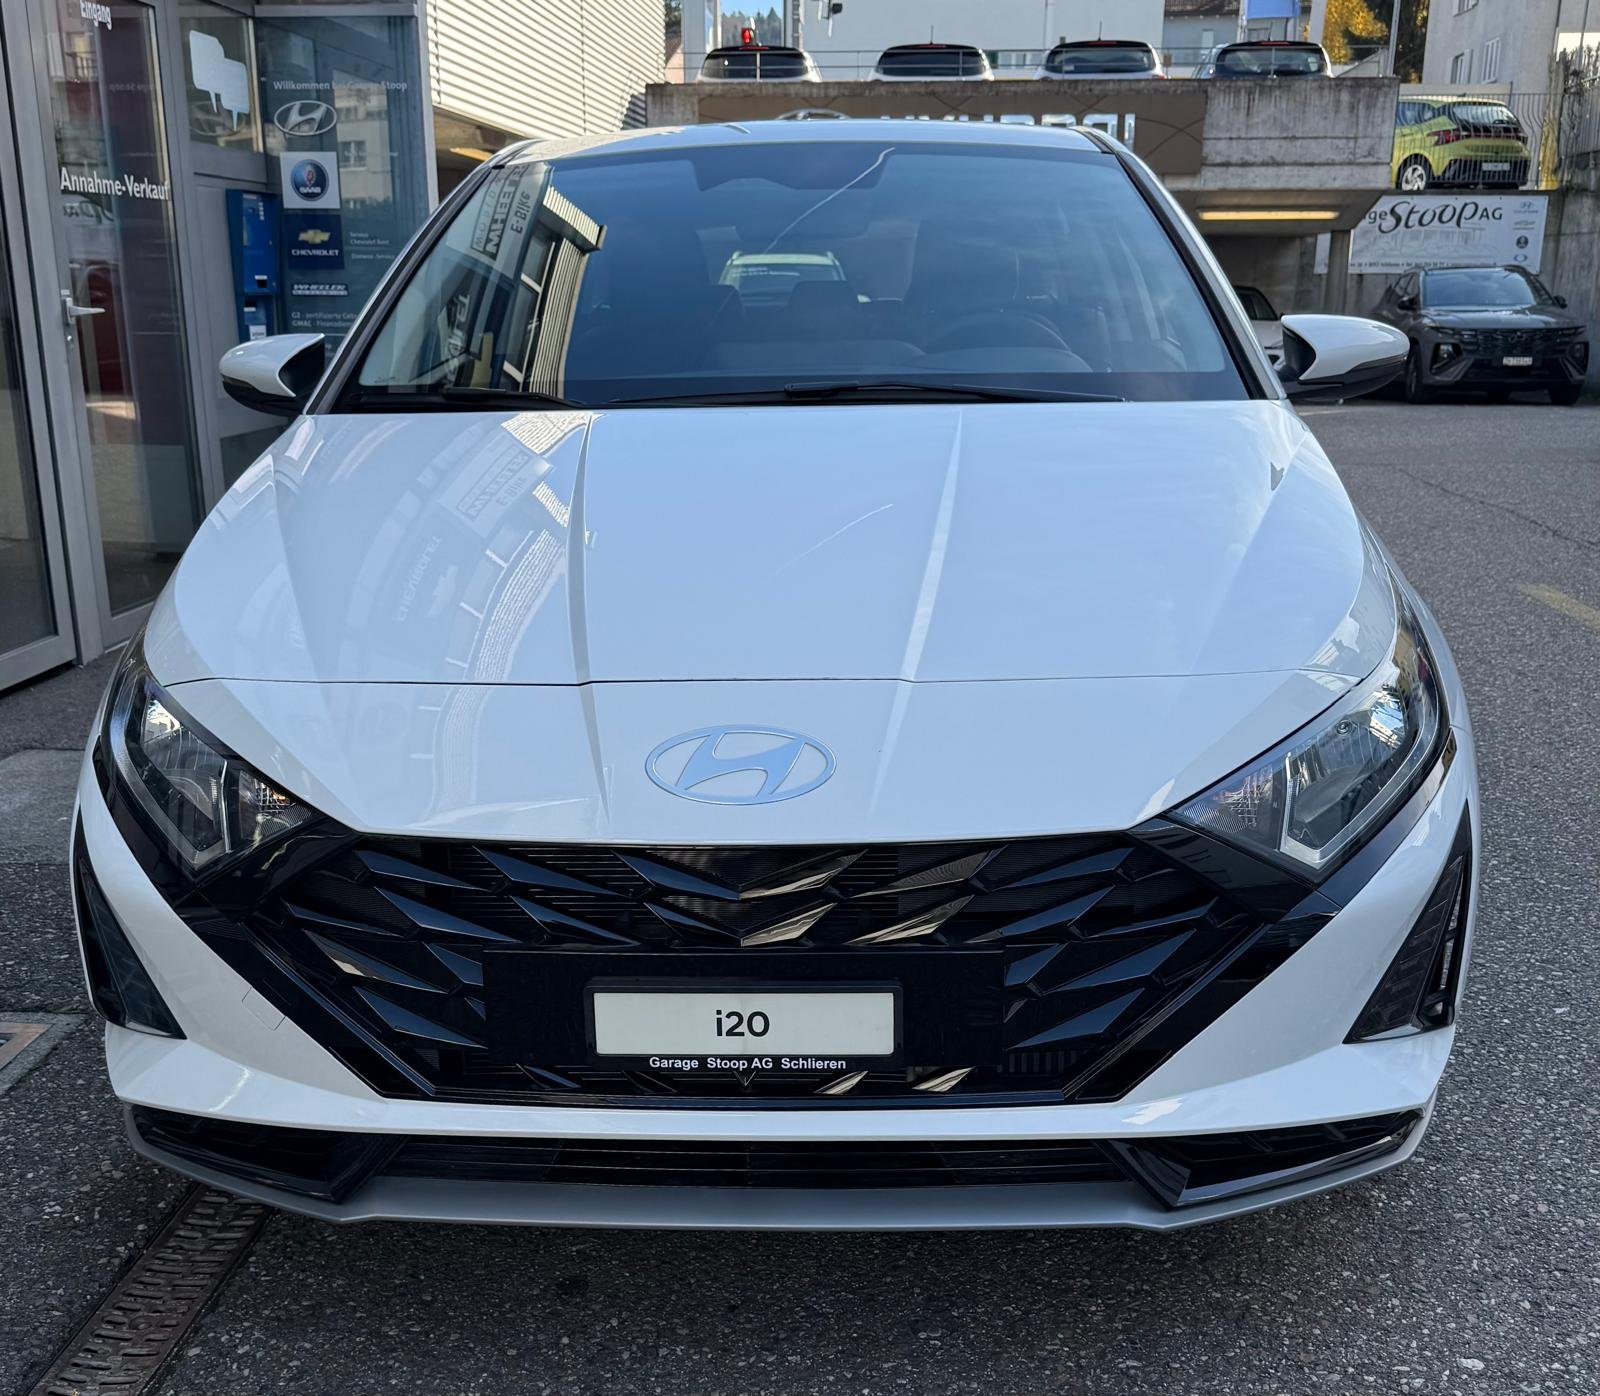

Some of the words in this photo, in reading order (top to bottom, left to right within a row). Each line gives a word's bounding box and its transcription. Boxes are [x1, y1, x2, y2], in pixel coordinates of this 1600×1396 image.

[80, 0, 112, 31] Eingang
[273, 81, 330, 90] Willkommen
[60, 167, 169, 200] Annahme-Verkauf
[1363, 210, 1388, 224] ge
[1378, 200, 1479, 234] Stoop
[1478, 207, 1503, 220] AG
[715, 1009, 770, 1037] i20
[649, 1057, 699, 1070] Garage
[706, 1057, 748, 1070] Stoop
[751, 1057, 773, 1068] AG
[780, 1057, 846, 1069] Schlieren
